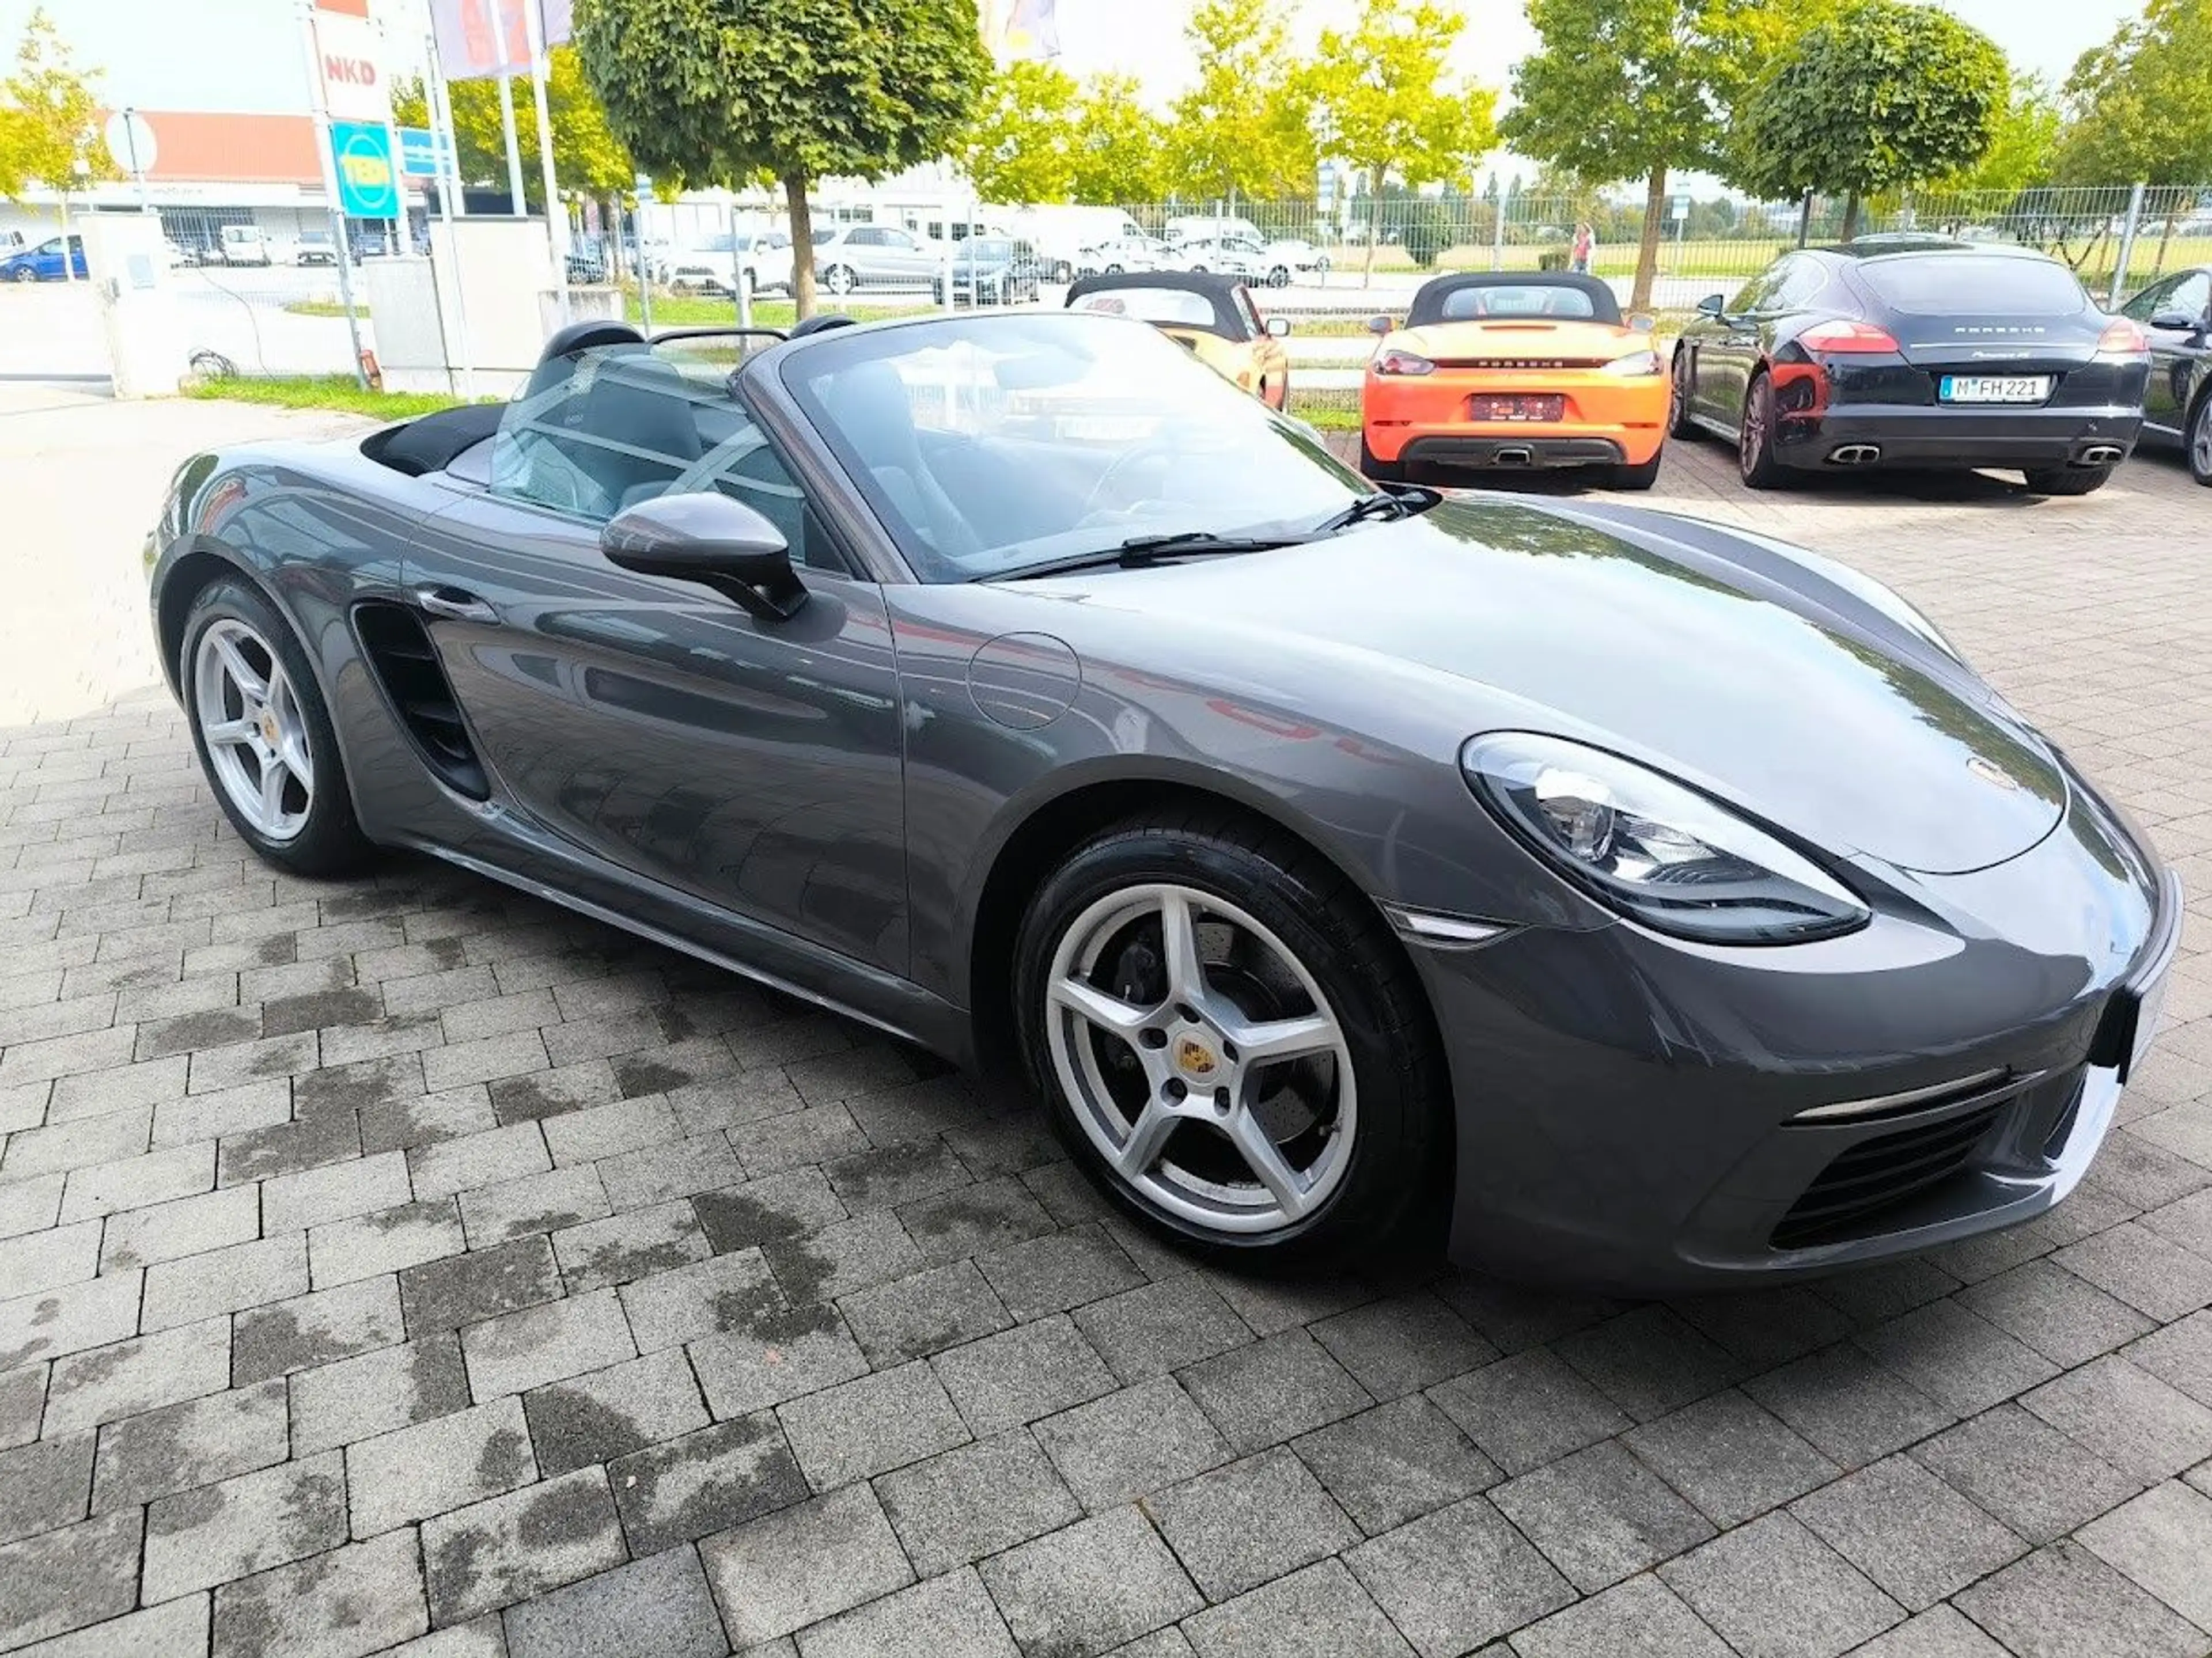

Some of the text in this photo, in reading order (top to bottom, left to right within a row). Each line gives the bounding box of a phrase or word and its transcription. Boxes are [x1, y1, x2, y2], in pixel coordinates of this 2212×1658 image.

[325, 54, 376, 86] NKD
[1957, 380, 2037, 396] M FH 221
